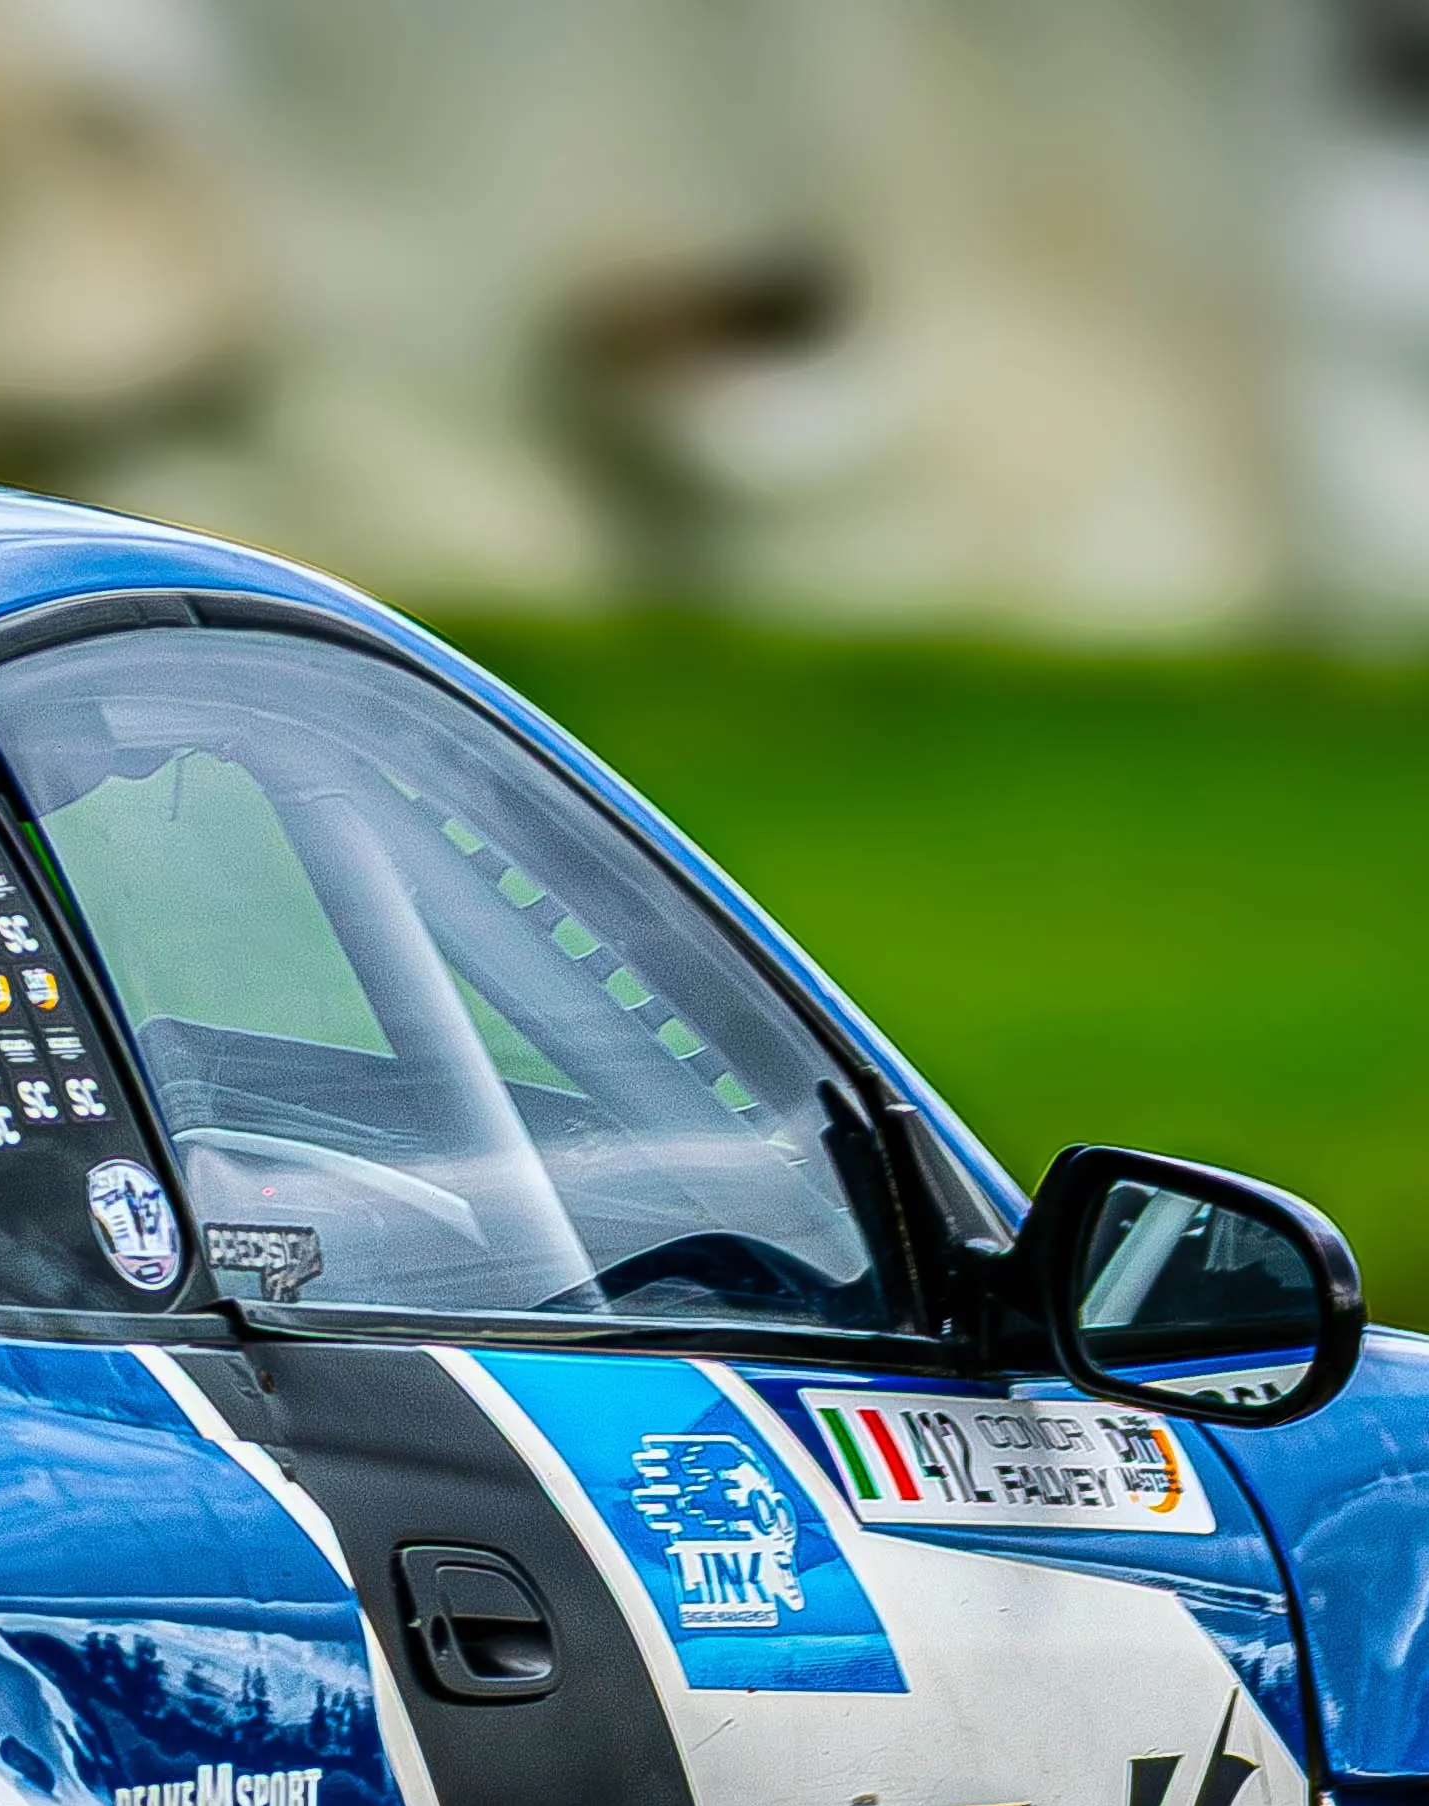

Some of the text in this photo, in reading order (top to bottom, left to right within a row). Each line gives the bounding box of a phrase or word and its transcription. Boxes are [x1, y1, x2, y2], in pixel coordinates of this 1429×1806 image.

[974, 1413, 1092, 1451] CONOR
[899, 1411, 996, 1502] 42
[994, 1465, 1118, 1507] FALVEY
